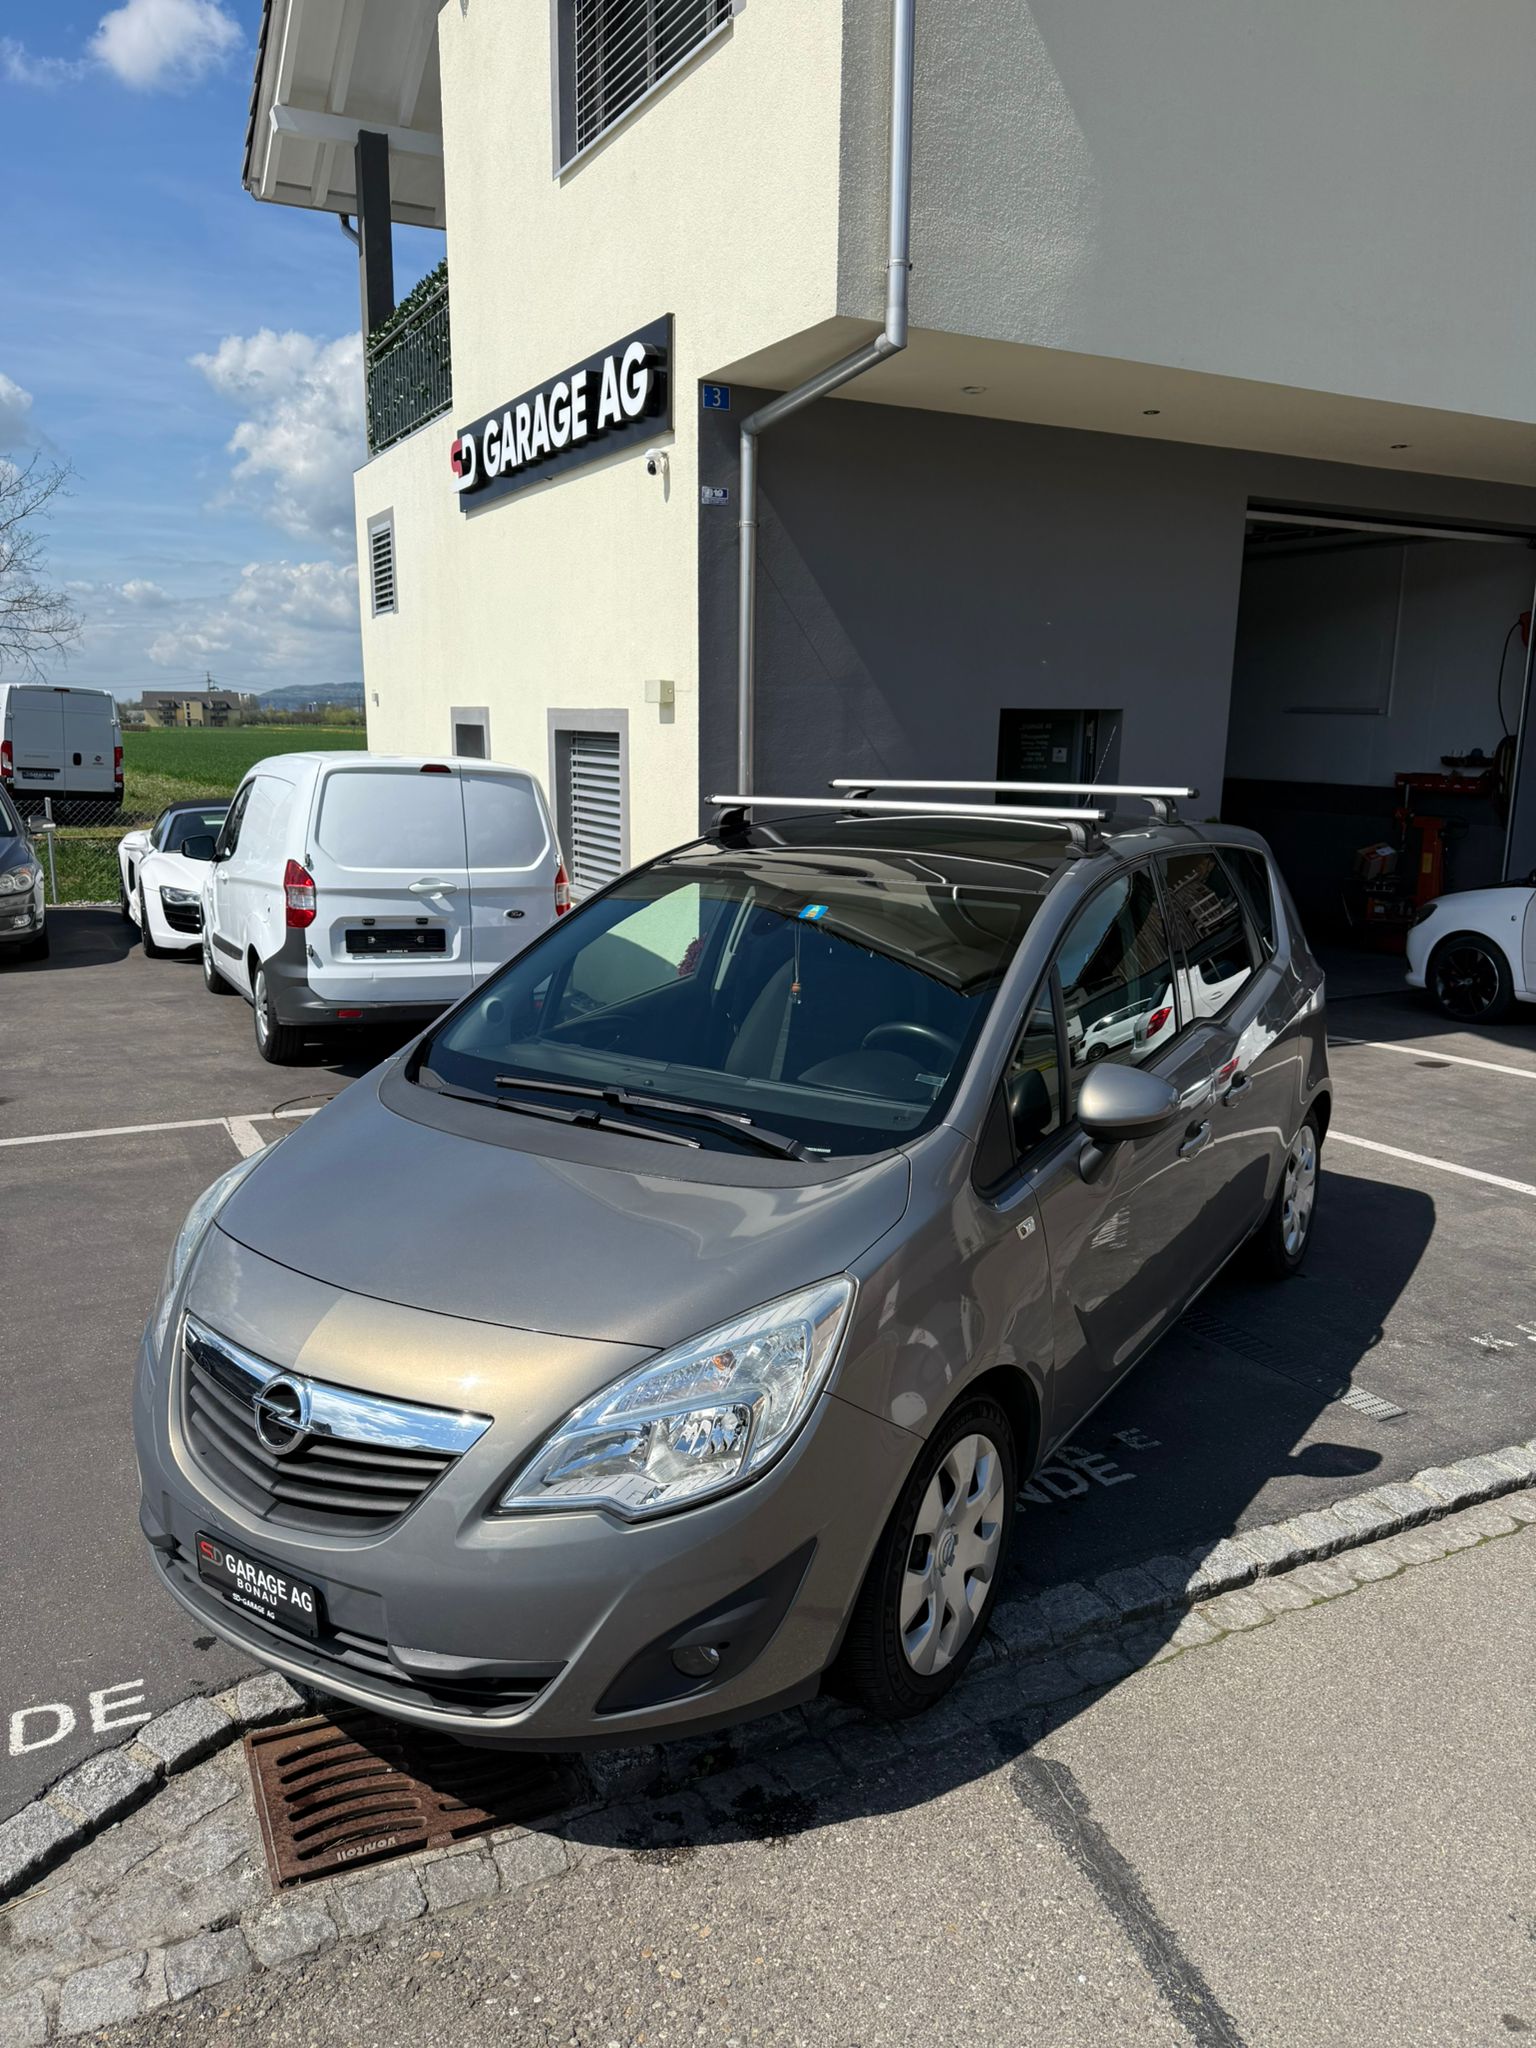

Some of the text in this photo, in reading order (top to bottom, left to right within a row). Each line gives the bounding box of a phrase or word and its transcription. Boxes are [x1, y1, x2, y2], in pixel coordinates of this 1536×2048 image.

[483, 369, 588, 478] GARAGE
[597, 341, 649, 429] AG
[712, 387, 721, 407] 3
[200, 1541, 313, 1612] SD GARAGE AG
[237, 1578, 277, 1605] BONAU
[266, 1609, 275, 1619] AG
